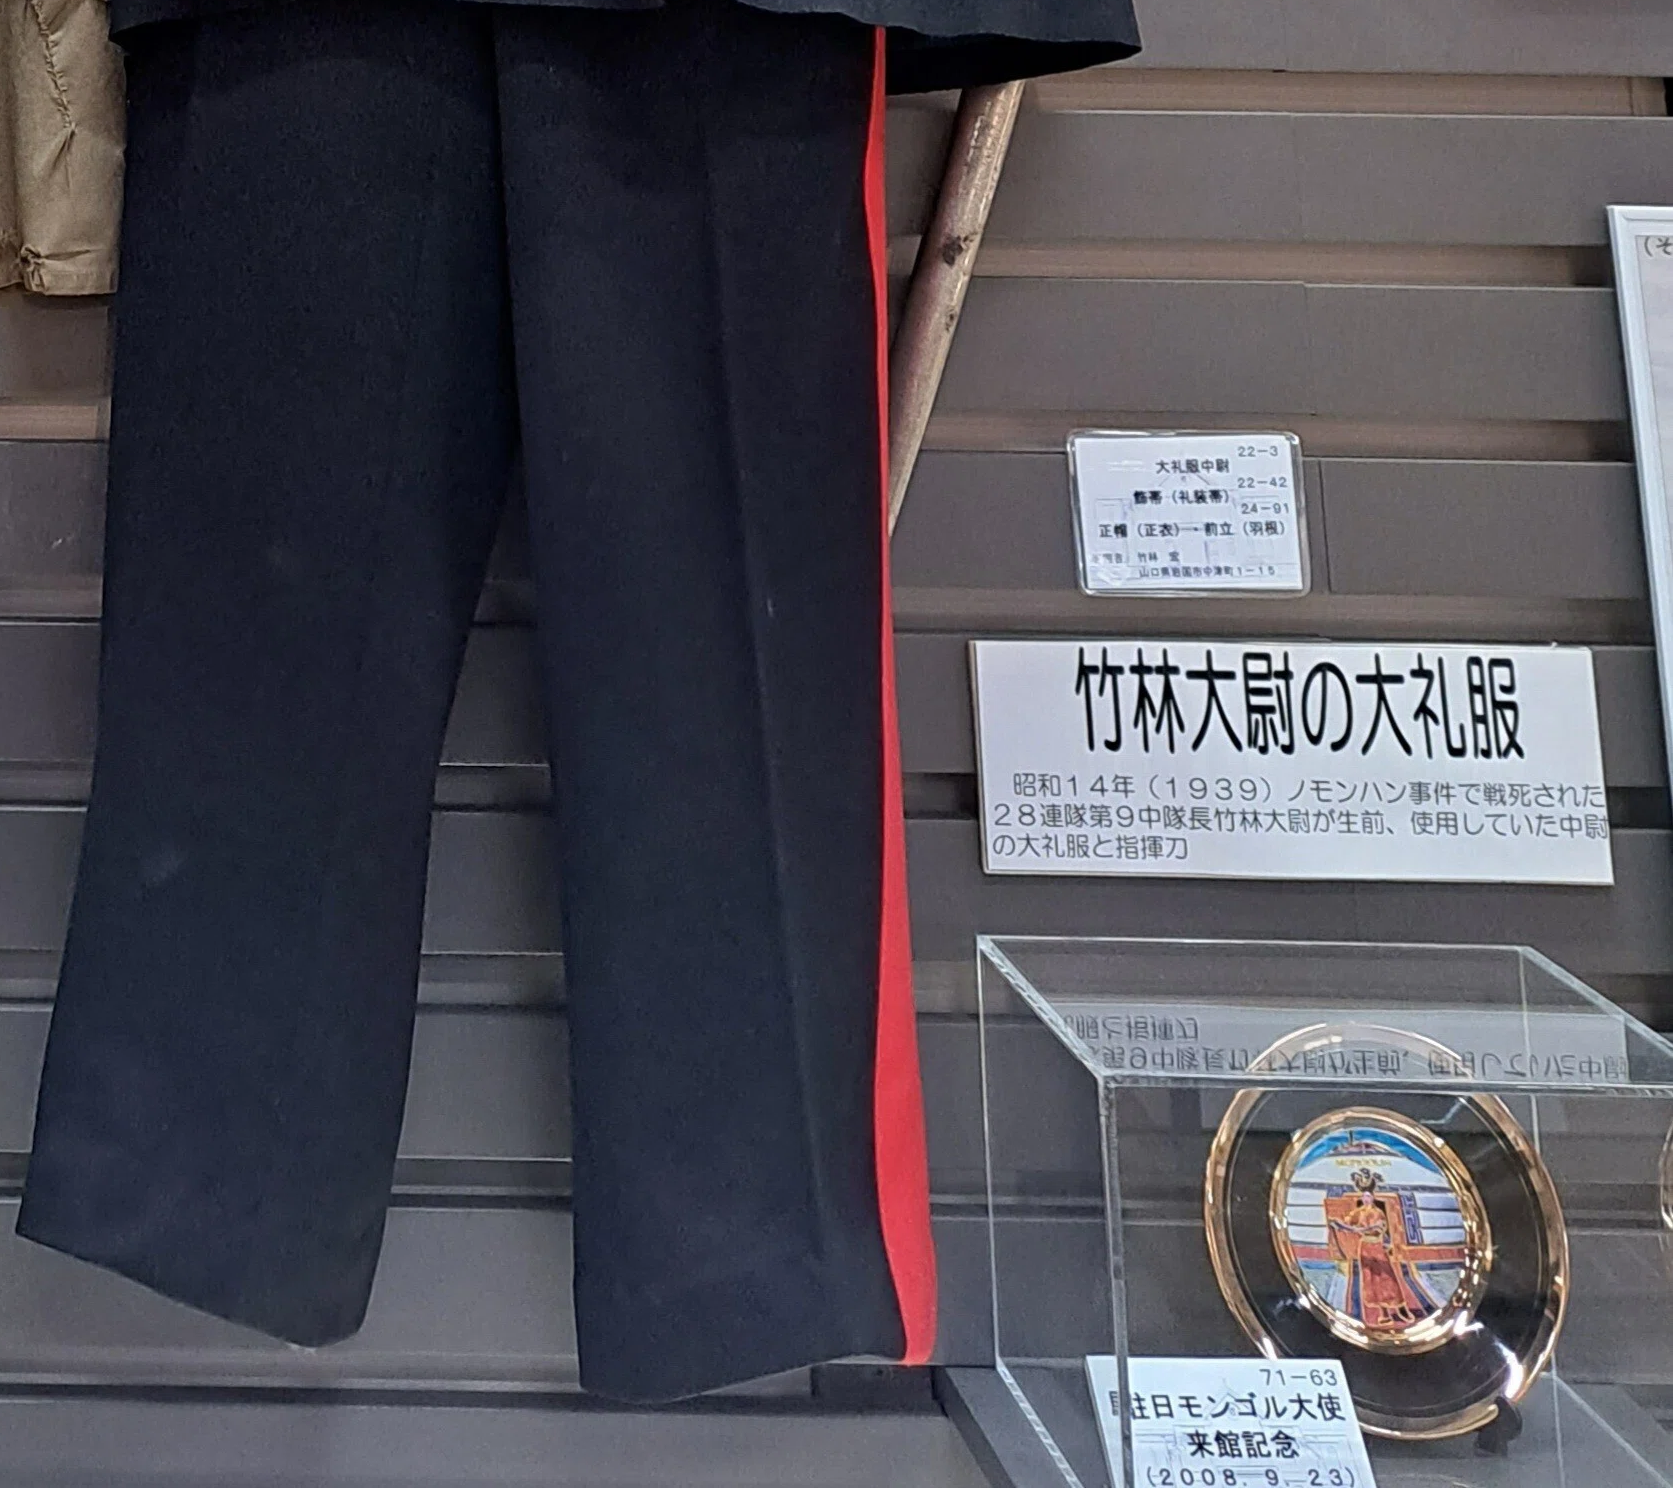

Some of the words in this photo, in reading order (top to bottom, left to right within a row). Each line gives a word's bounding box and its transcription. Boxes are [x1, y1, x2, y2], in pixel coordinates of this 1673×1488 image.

[1075, 645, 1526, 760] 竹林大尉の大礼服
[992, 831, 1189, 861] の大礼服と指揮刀
[1259, 1369, 1338, 1386] 71-63
[1187, 1429, 1300, 1459] 来館記念
